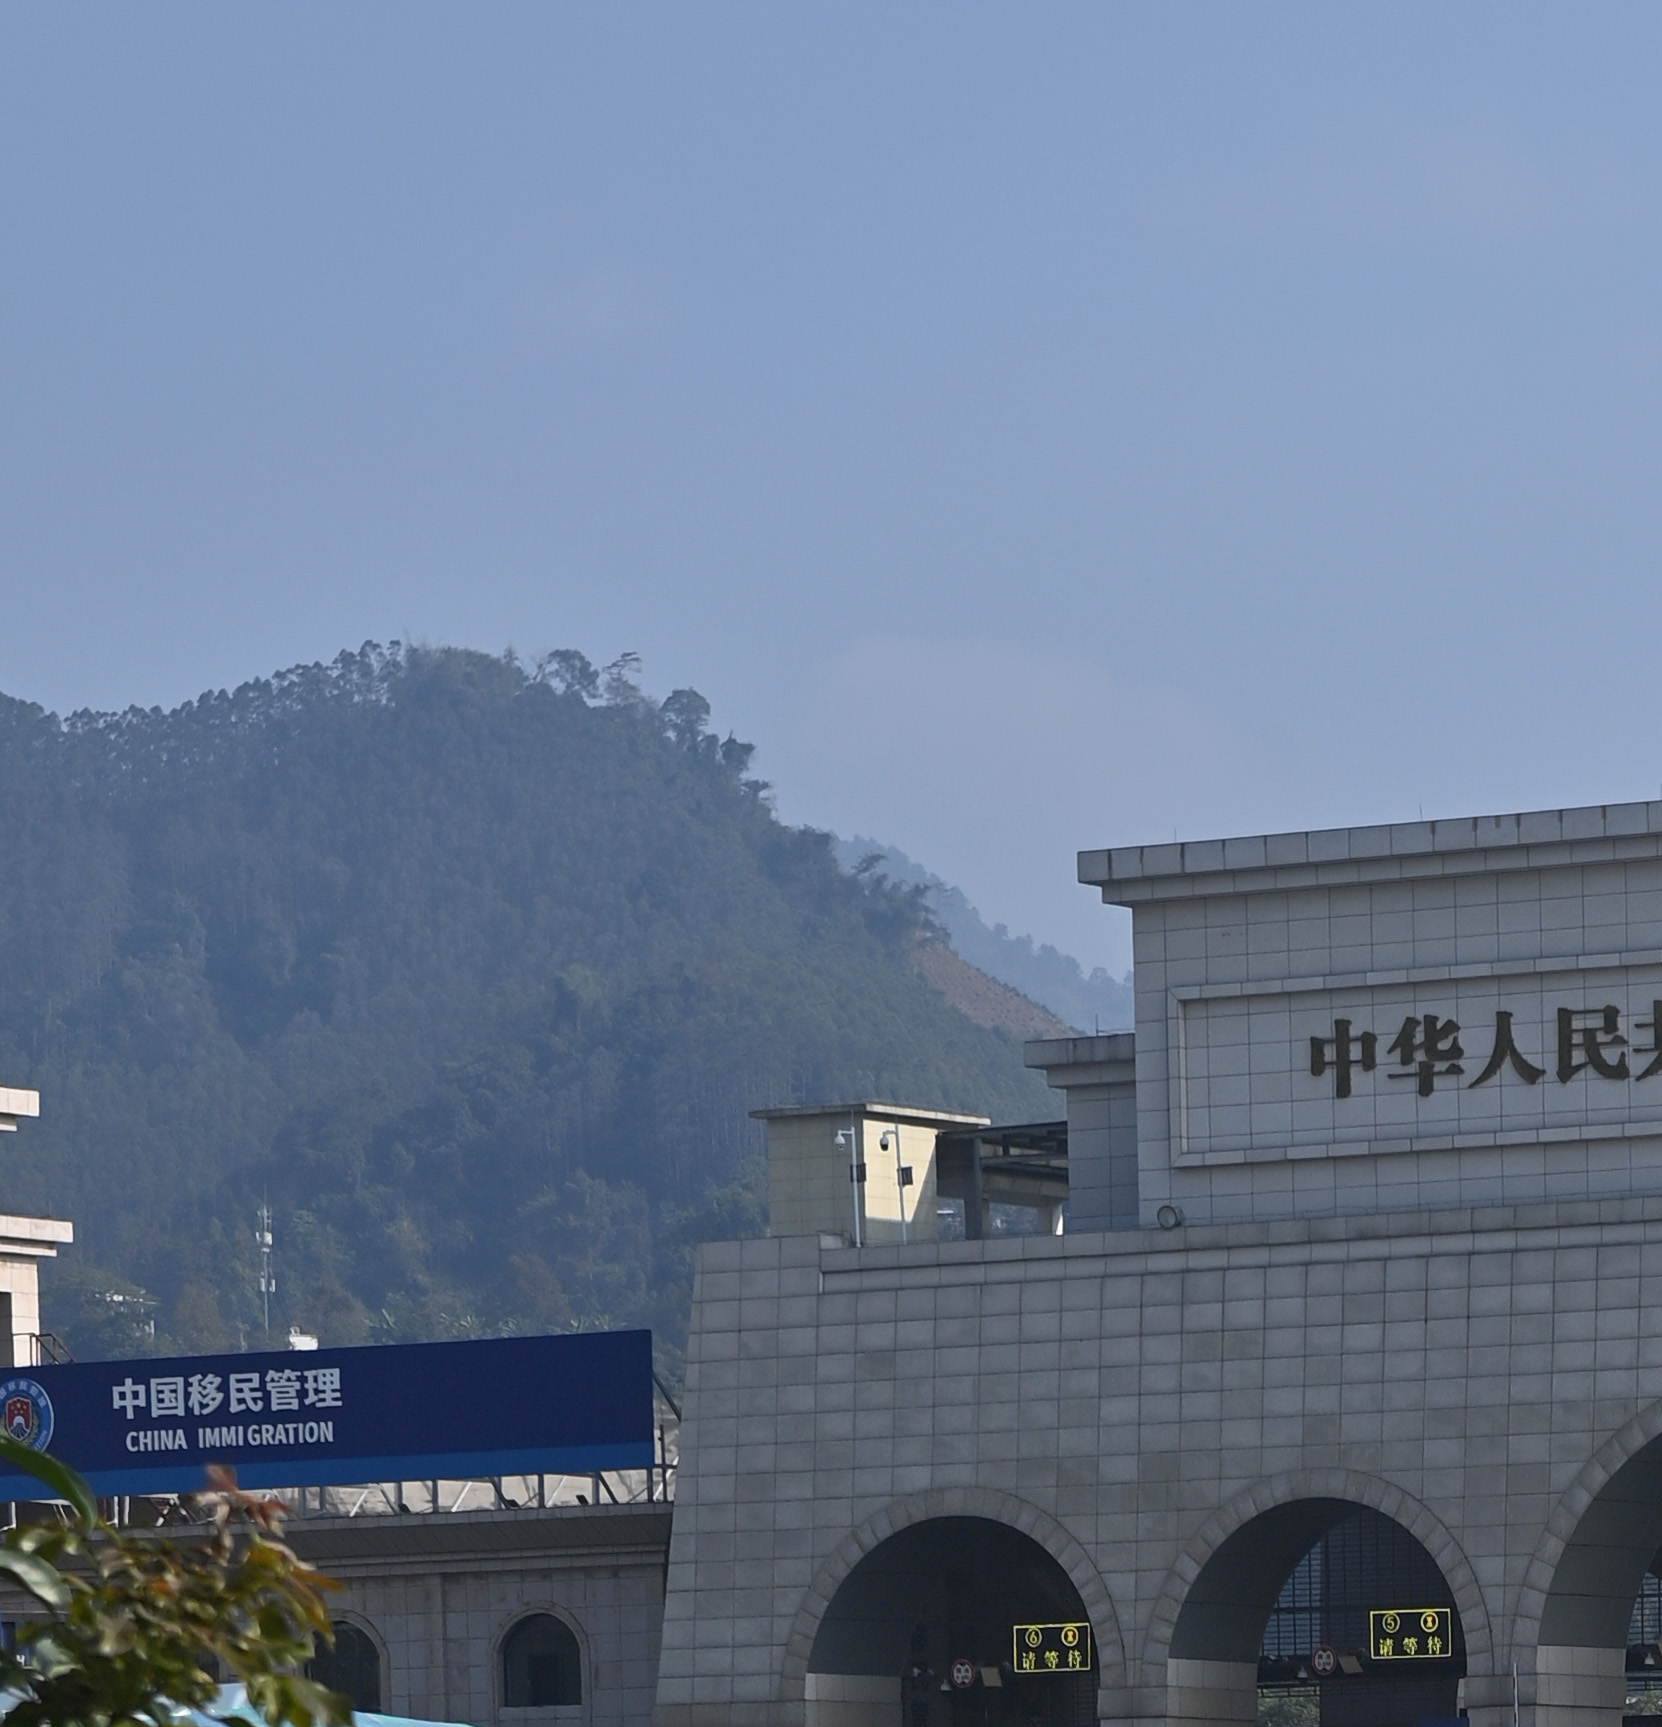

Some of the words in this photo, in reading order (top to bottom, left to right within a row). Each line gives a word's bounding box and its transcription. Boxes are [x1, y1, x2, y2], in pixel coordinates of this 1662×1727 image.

[112, 1368, 342, 1420] 中国移民管理
[126, 1429, 188, 1452] CHINA
[198, 1421, 334, 1449] IMMIGRATION
[1379, 1636, 1442, 1657] 请等待
[1022, 1650, 1082, 1670] 请等待
